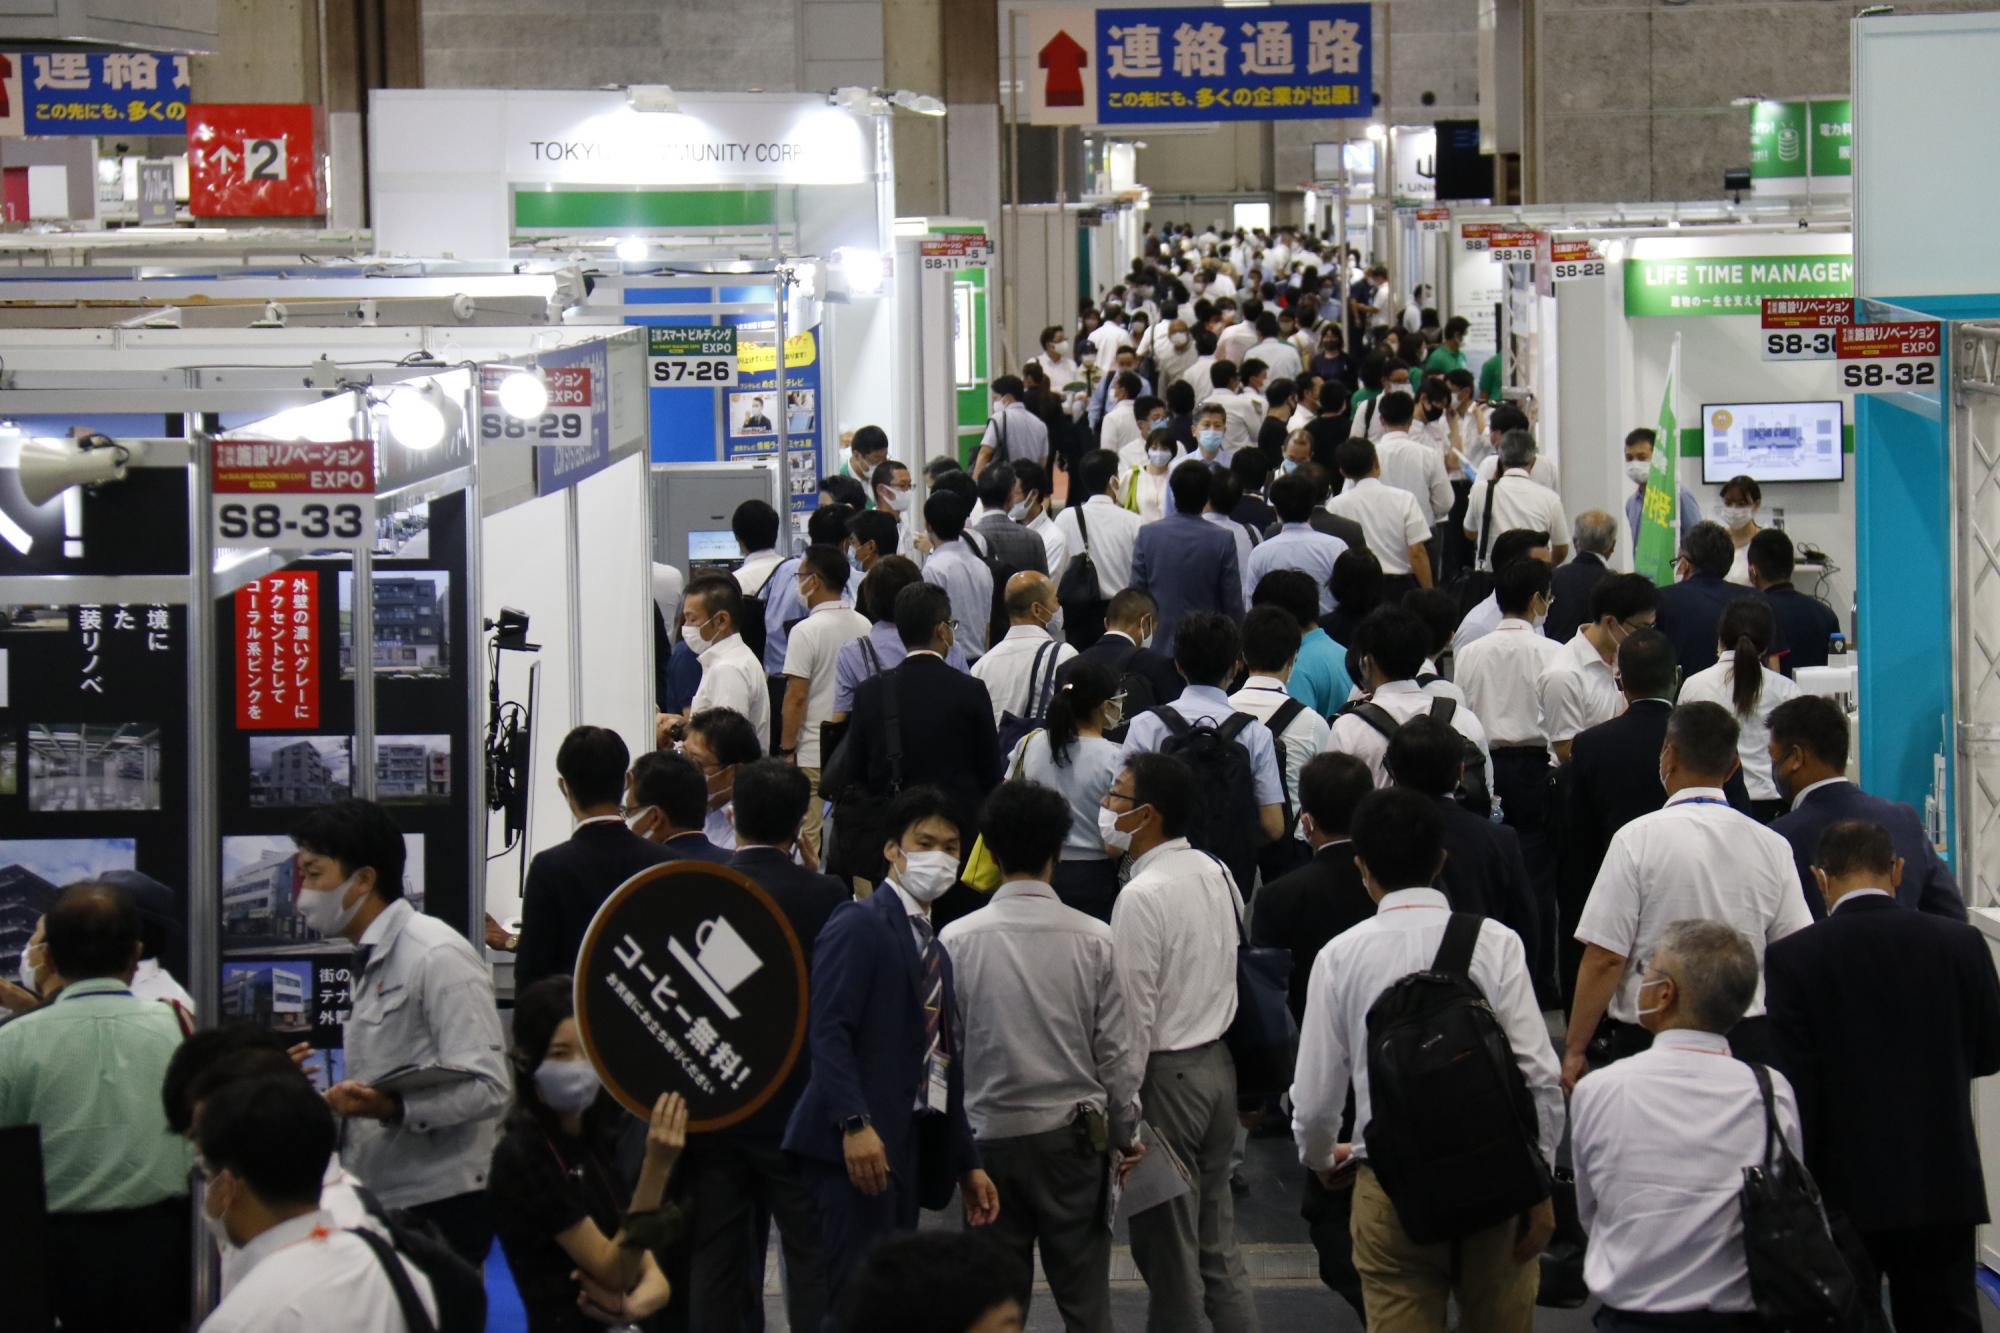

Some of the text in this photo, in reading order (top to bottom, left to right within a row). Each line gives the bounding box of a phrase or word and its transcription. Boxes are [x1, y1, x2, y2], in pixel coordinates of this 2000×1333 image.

[1107, 19, 1362, 78] 連絡通路
[33, 53, 190, 90] 連絡
[251, 140, 280, 180] 2
[530, 141, 602, 161] TOKY
[1494, 249, 1533, 261] S8-16
[1555, 263, 1605, 278] S8-22
[1645, 264, 1688, 287] LIFE
[1695, 264, 1744, 284] TIME
[1818, 315, 1850, 326] EXPO
[702, 343, 732, 354] EXPO
[1901, 342, 1936, 354] EXPO
[654, 361, 730, 382] S7-26
[1843, 362, 1936, 388] S8-32
[480, 413, 582, 439] S8-29
[236, 444, 364, 468] 施設リノベーション
[310, 470, 365, 489] EXPO
[219, 503, 363, 539] S8-33
[79, 602, 104, 694] 装リノベ
[246, 579, 263, 720] コーラル系ピンクを
[270, 579, 286, 704] アクセントとして
[292, 578, 310, 719] 外壁の濃いグレーに
[612, 933, 753, 1091] コーヒー無料!
